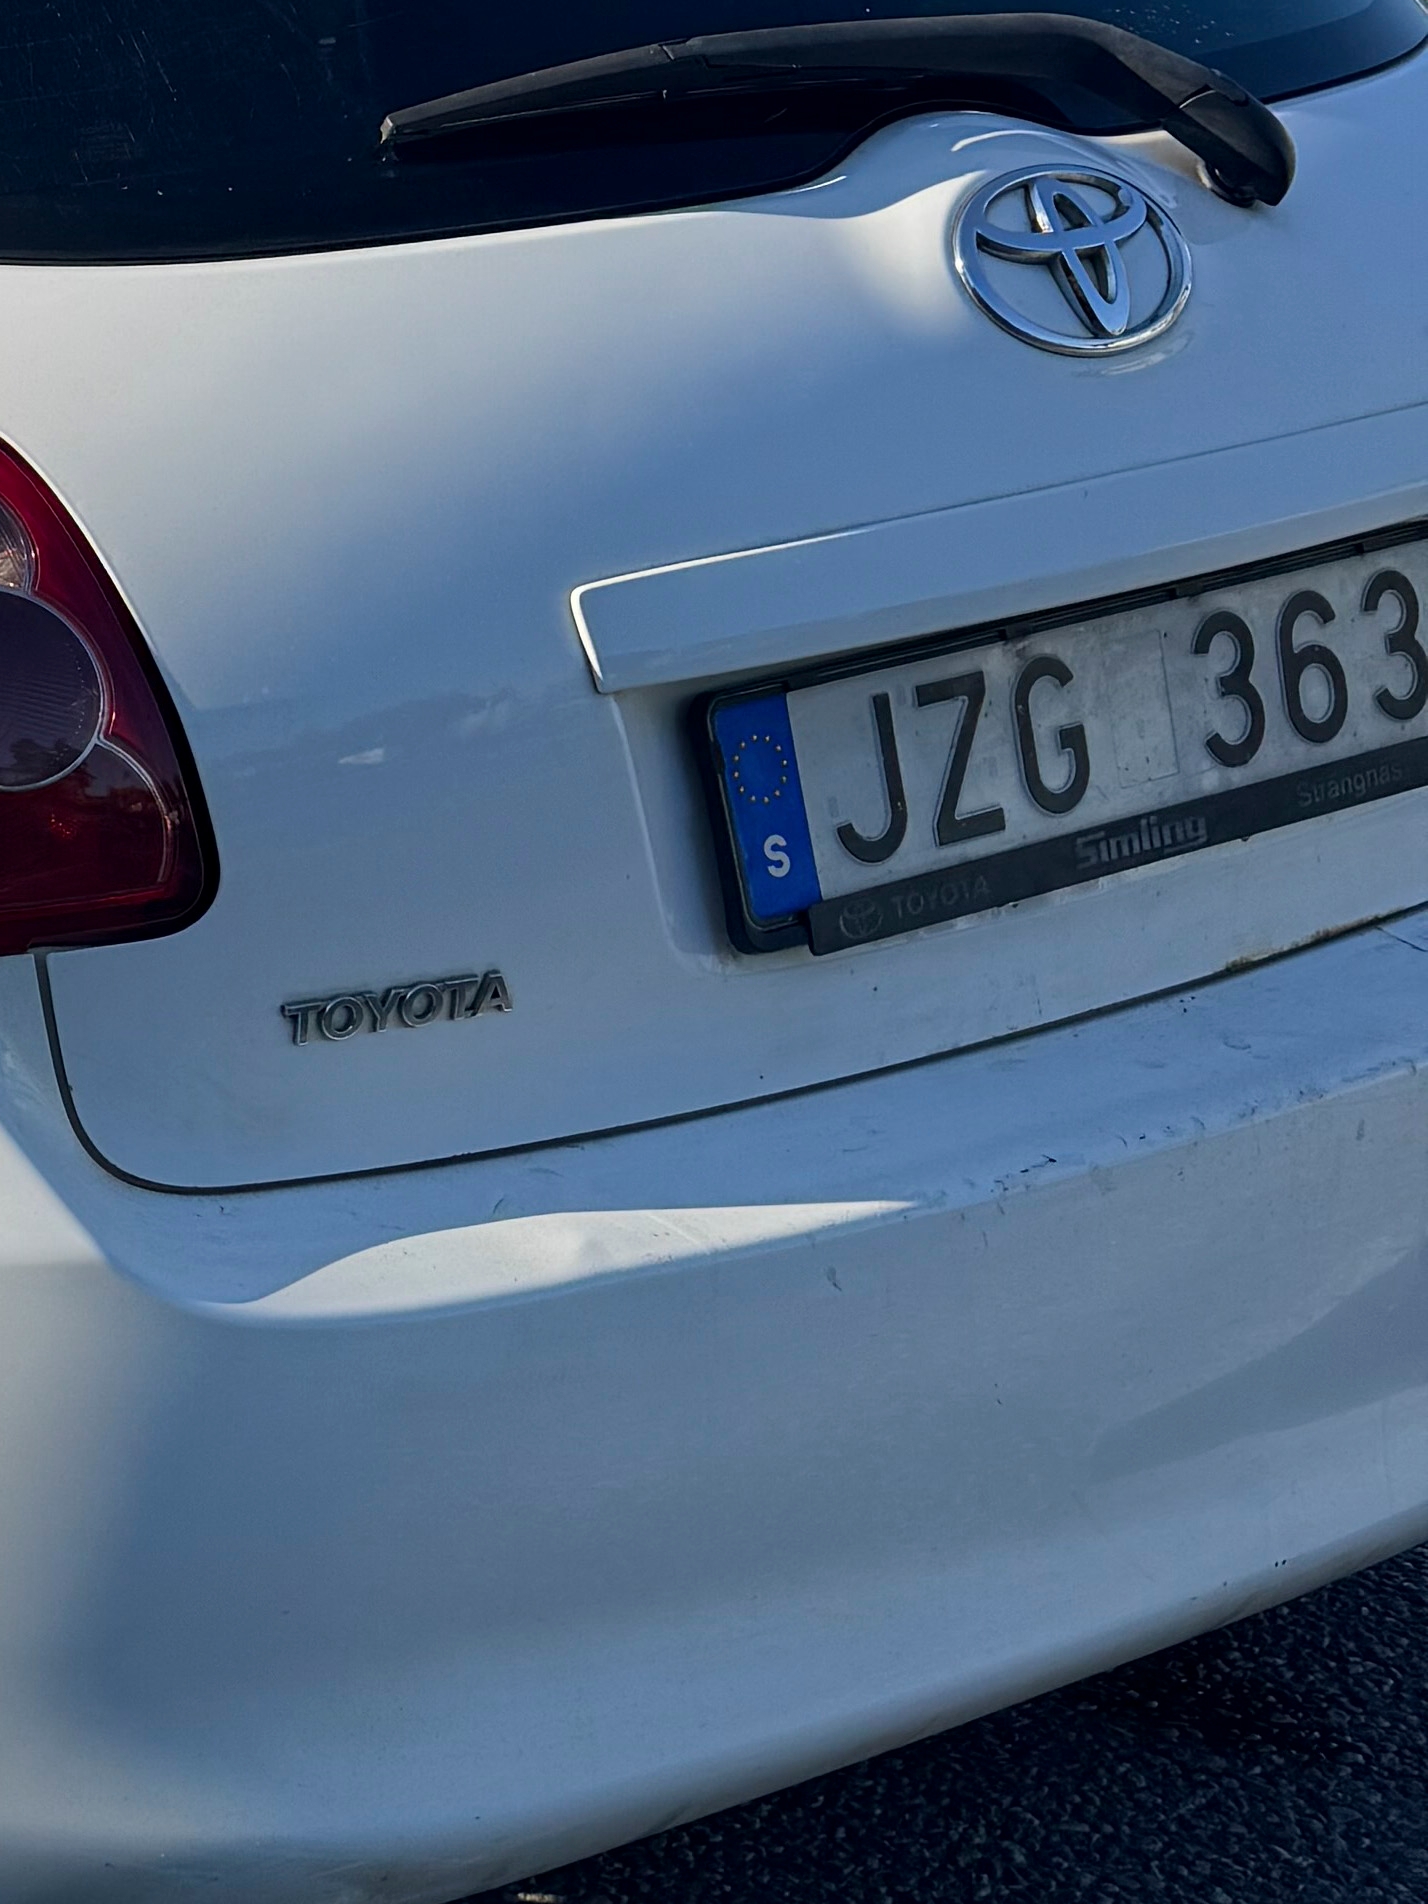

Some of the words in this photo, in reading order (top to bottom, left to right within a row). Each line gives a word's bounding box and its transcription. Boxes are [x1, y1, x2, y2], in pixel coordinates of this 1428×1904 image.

[836, 655, 1091, 865] JZG
[1190, 569, 1428, 768] 363
[763, 834, 791, 878] S
[891, 874, 992, 919] TOYOTA
[280, 969, 513, 1046] TOYOTA
